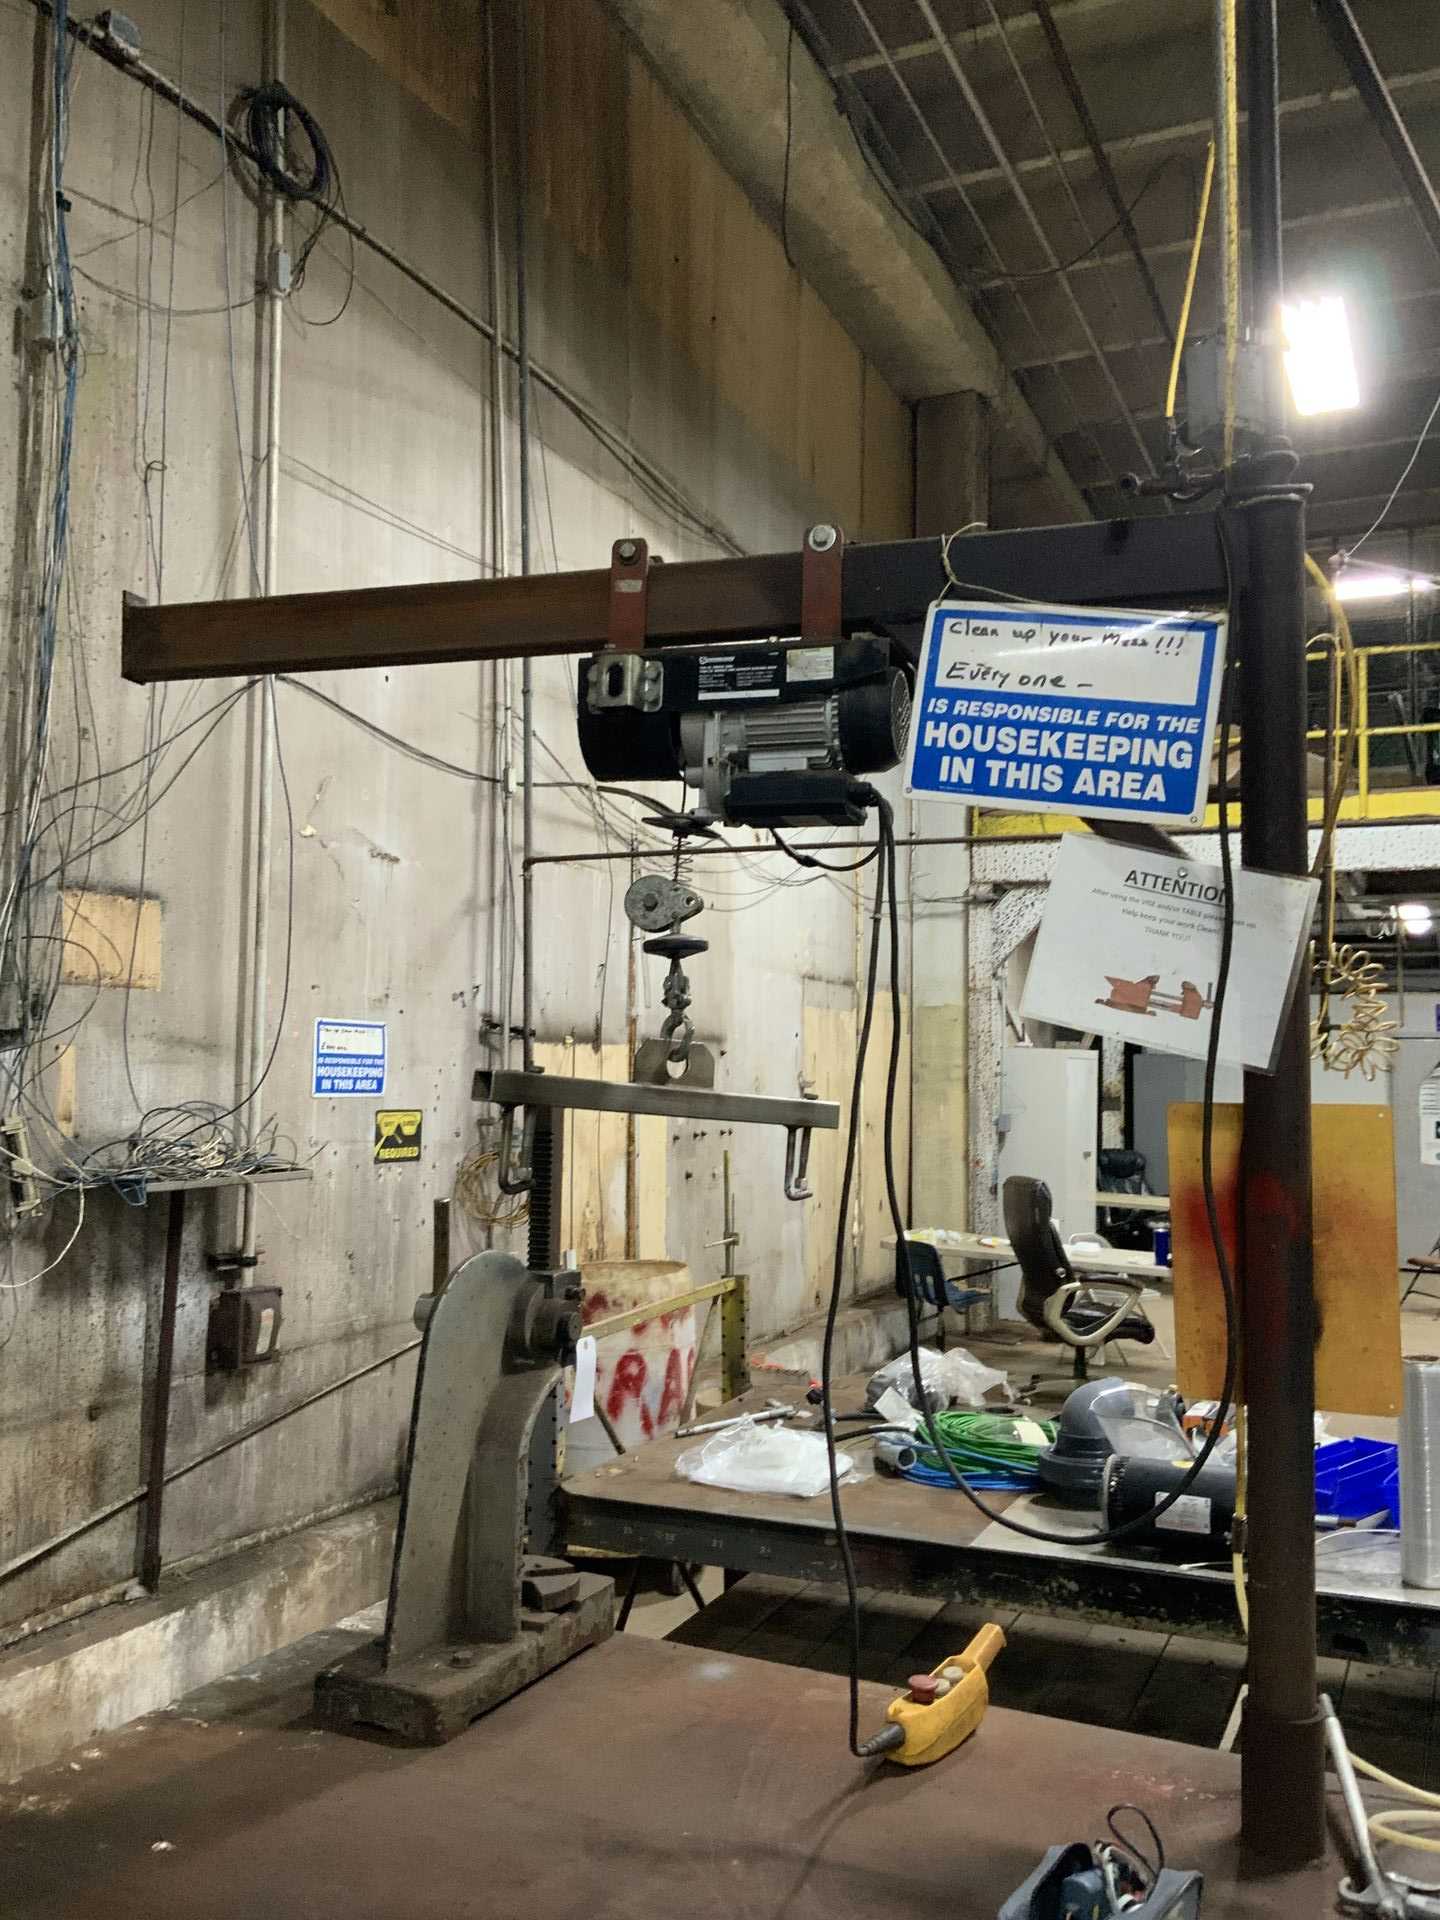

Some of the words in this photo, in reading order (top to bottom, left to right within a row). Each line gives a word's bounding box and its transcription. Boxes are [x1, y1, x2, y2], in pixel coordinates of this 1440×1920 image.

[950, 620, 999, 637] Clean
[1012, 628, 1036, 644] up
[1050, 631, 1092, 646] your
[927, 698, 949, 714] IS
[952, 700, 1101, 726] RESPONSIBLE
[1104, 711, 1150, 730] FOR
[1157, 715, 1201, 734] THE
[924, 720, 1193, 769] HOUSEKEEPING
[939, 755, 975, 784] IN
[986, 759, 1064, 792] THIS
[1072, 768, 1166, 802] AREA
